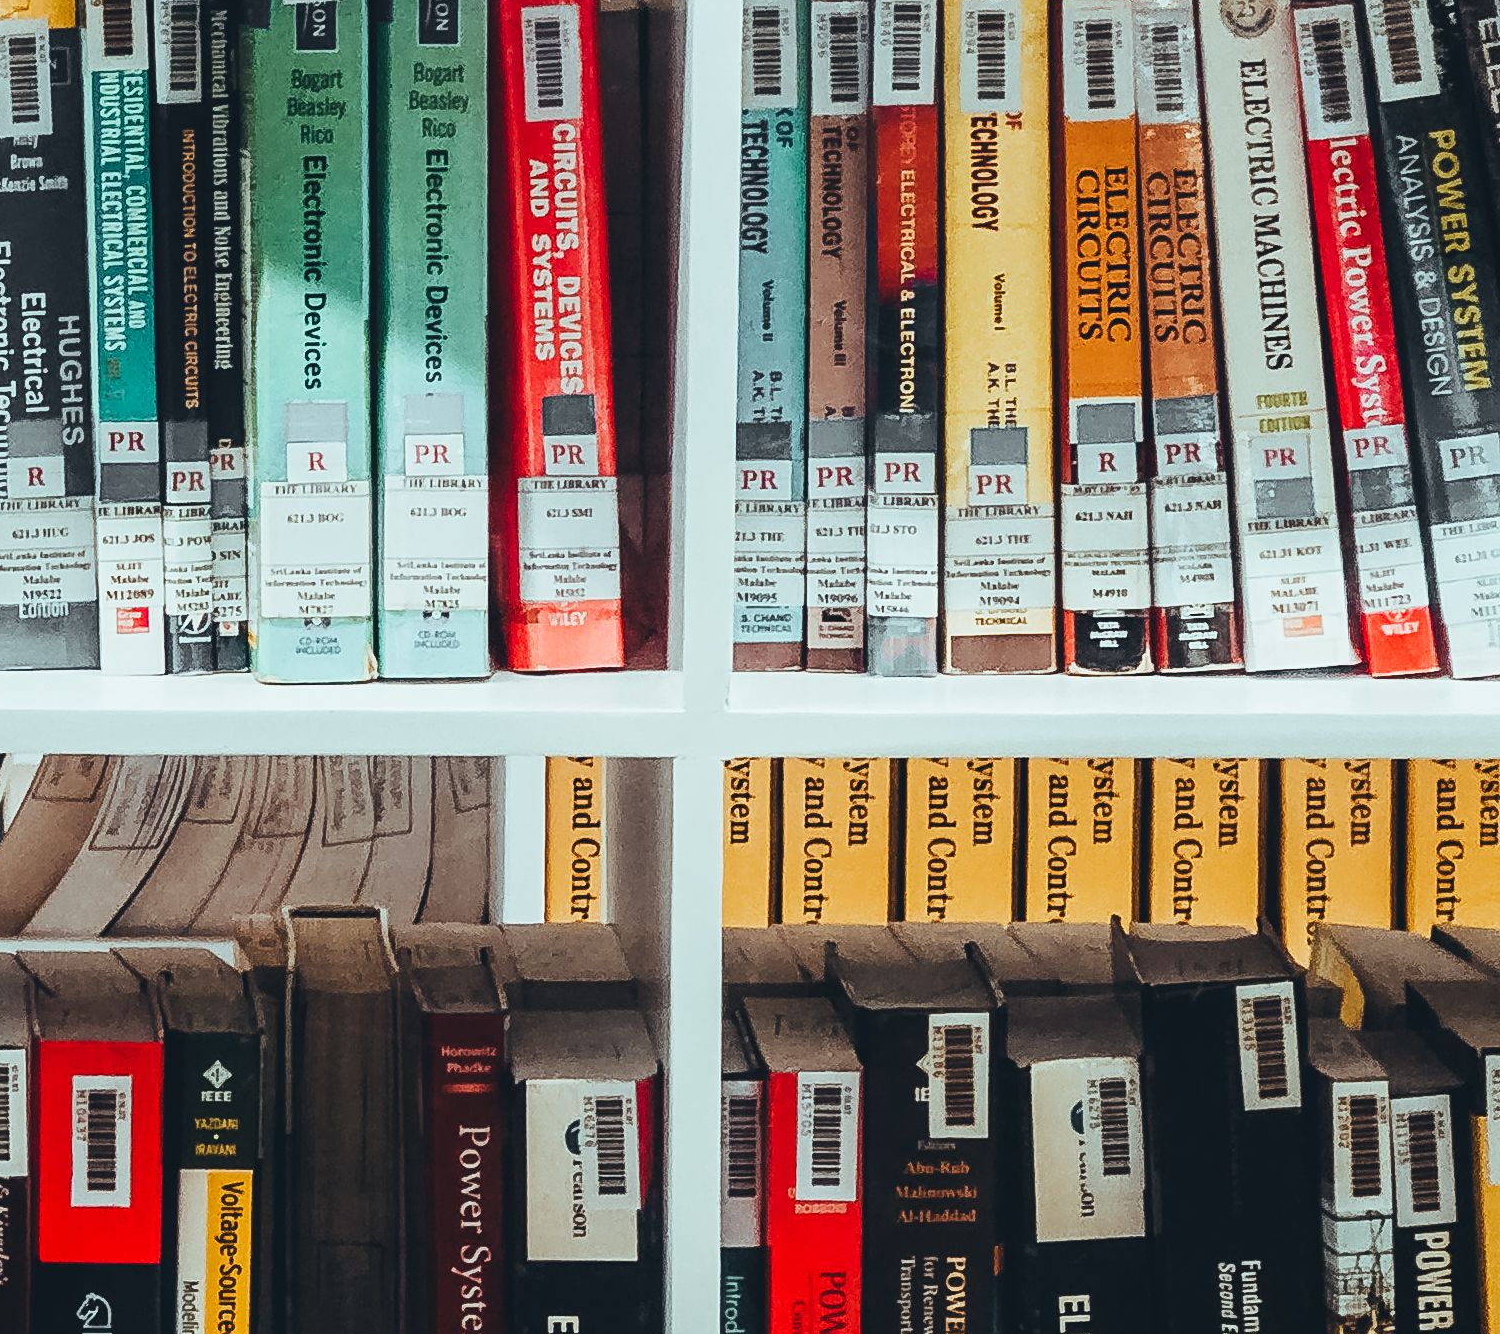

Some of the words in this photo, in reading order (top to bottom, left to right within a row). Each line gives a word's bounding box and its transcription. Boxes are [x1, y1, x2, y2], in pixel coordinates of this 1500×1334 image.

[287, 98, 346, 118] Beasley
[291, 70, 342, 91] Bogart
[10, 156, 43, 171] Brown
[300, 125, 334, 145] Rico
[1239, 59, 1276, 206] ELECTRIC
[37, 177, 69, 192] Smith
[102, 173, 126, 274] ELECTRICAL
[182, 129, 198, 237] INTRODUCTION
[302, 154, 327, 283] Electronic
[530, 159, 549, 221] AND
[552, 122, 581, 259] CIRCUITS,
[1395, 135, 1436, 261] ANALYSIS
[1428, 129, 1472, 255] POWER
[182, 242, 198, 261] TO
[182, 265, 199, 334] ELECTRIC
[530, 234, 553, 361] SYSTEMS
[1077, 168, 1103, 341] CIRCUITS
[1105, 166, 1132, 343] ELECTRIC
[1252, 212, 1294, 370] MACHINES
[1413, 272, 1436, 290] &
[103, 275, 127, 352] SYSTEMS
[303, 292, 325, 391] Devices
[555, 275, 585, 394] DEVICES
[1416, 299, 1453, 397] DESIGN
[1445, 265, 1493, 393] SYSTEM
[184, 337, 200, 410] CIRCUITS
[1256, 392, 1308, 409] FOURTH
[1259, 417, 1311, 433] EDITION
[201, 1090, 233, 1102] IEEE
[456, 1124, 492, 1234] Power
[1217, 1263, 1238, 1318] Second
[1414, 1230, 1453, 1332] POWER
